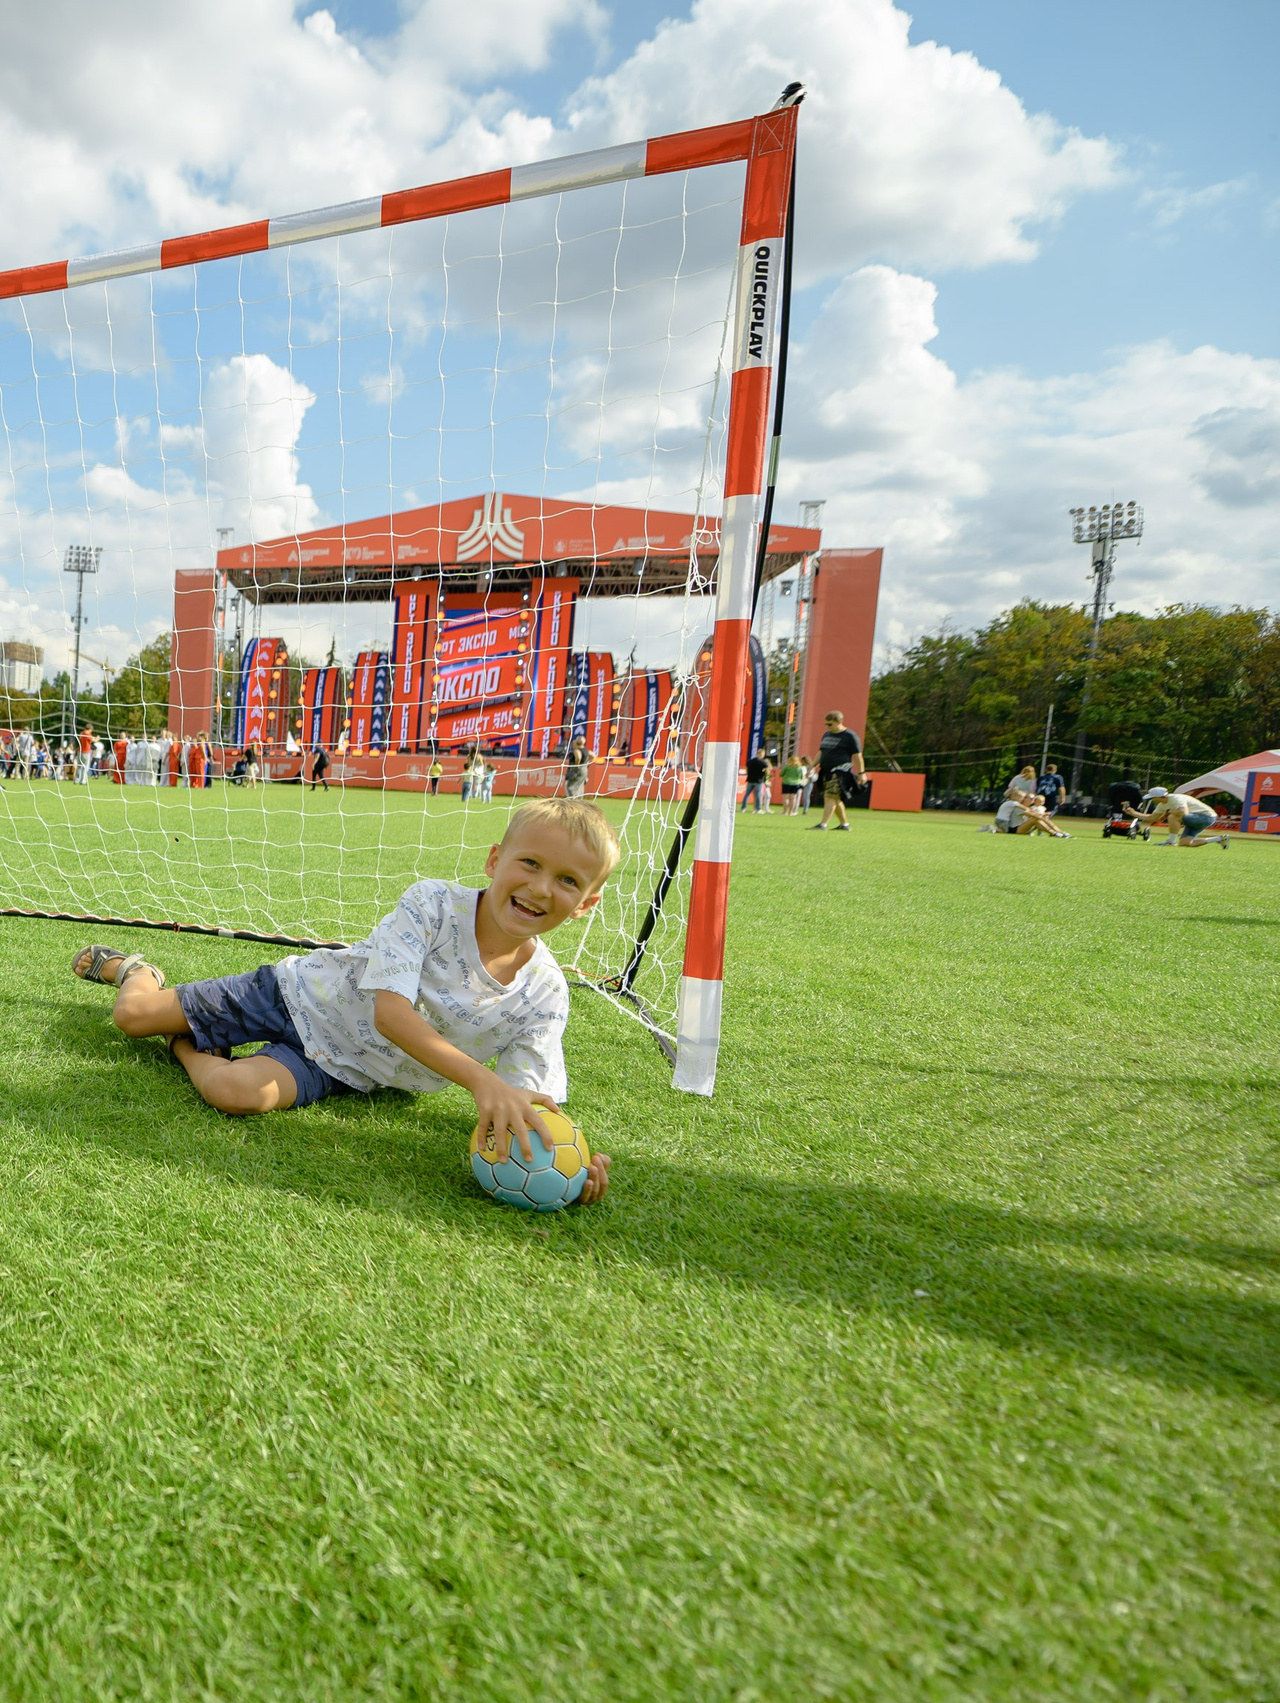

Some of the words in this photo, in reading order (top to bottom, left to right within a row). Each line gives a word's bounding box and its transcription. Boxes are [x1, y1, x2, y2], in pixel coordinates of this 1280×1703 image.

[748, 246, 771, 359] QUICKPLAY
[403, 632, 414, 694] ЭКСПО
[441, 639, 456, 655] РТ
[457, 629, 498, 653] ЭКСПО
[545, 656, 557, 722] СПОРТ
[436, 987, 485, 1027] OXYGEN
